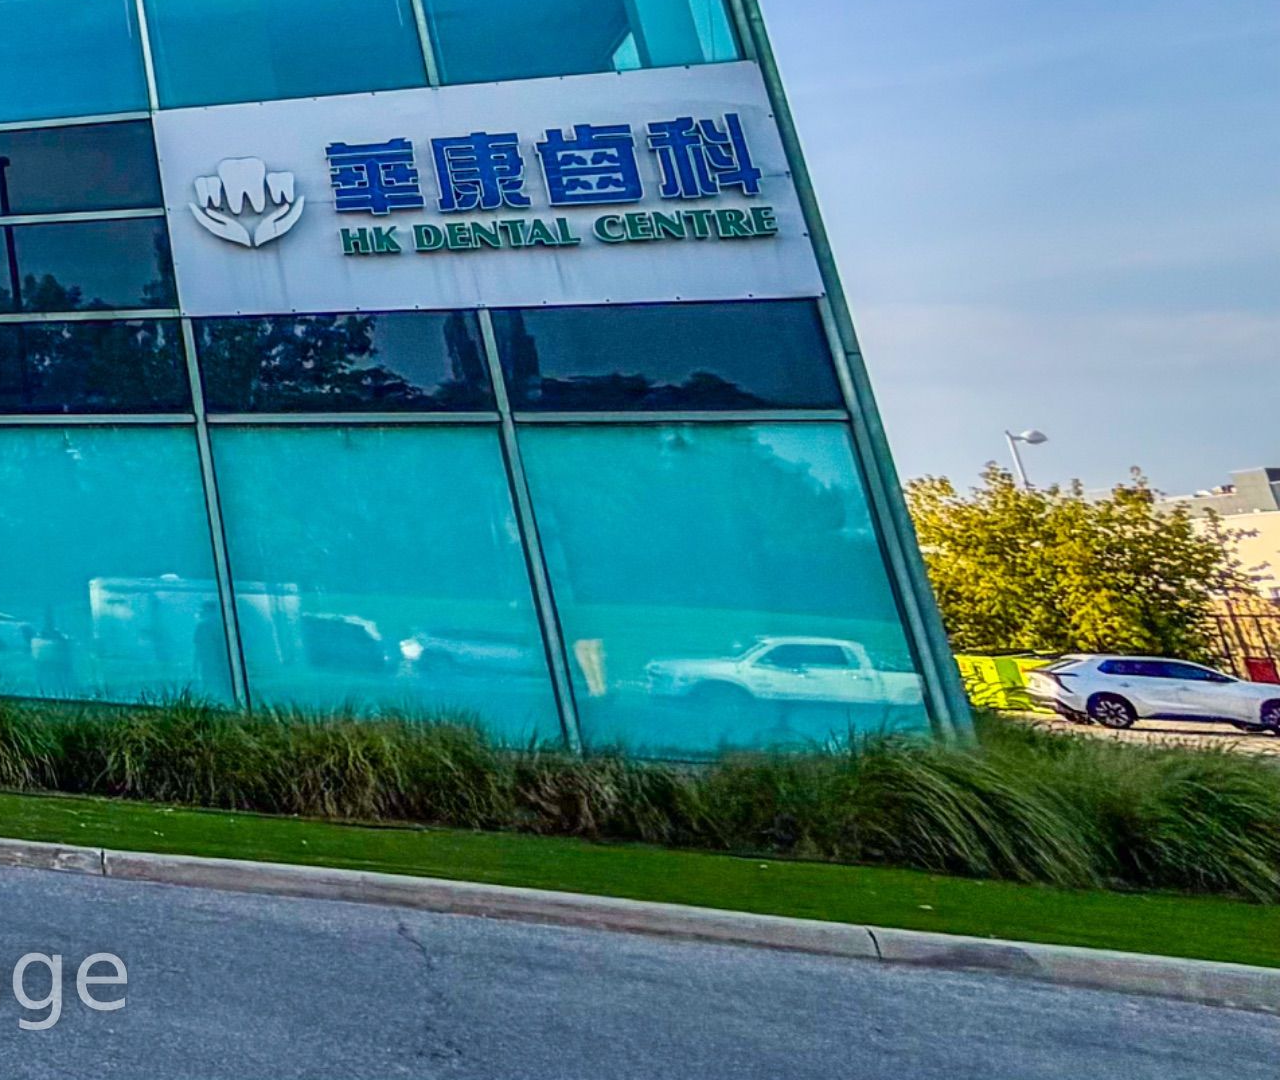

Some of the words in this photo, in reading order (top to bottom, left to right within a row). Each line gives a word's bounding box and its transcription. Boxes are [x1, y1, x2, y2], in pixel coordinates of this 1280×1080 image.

[325, 113, 762, 215] 華康齒科
[341, 225, 401, 255] HK
[413, 217, 581, 251] DENTAL
[593, 206, 778, 242] CENTRE
